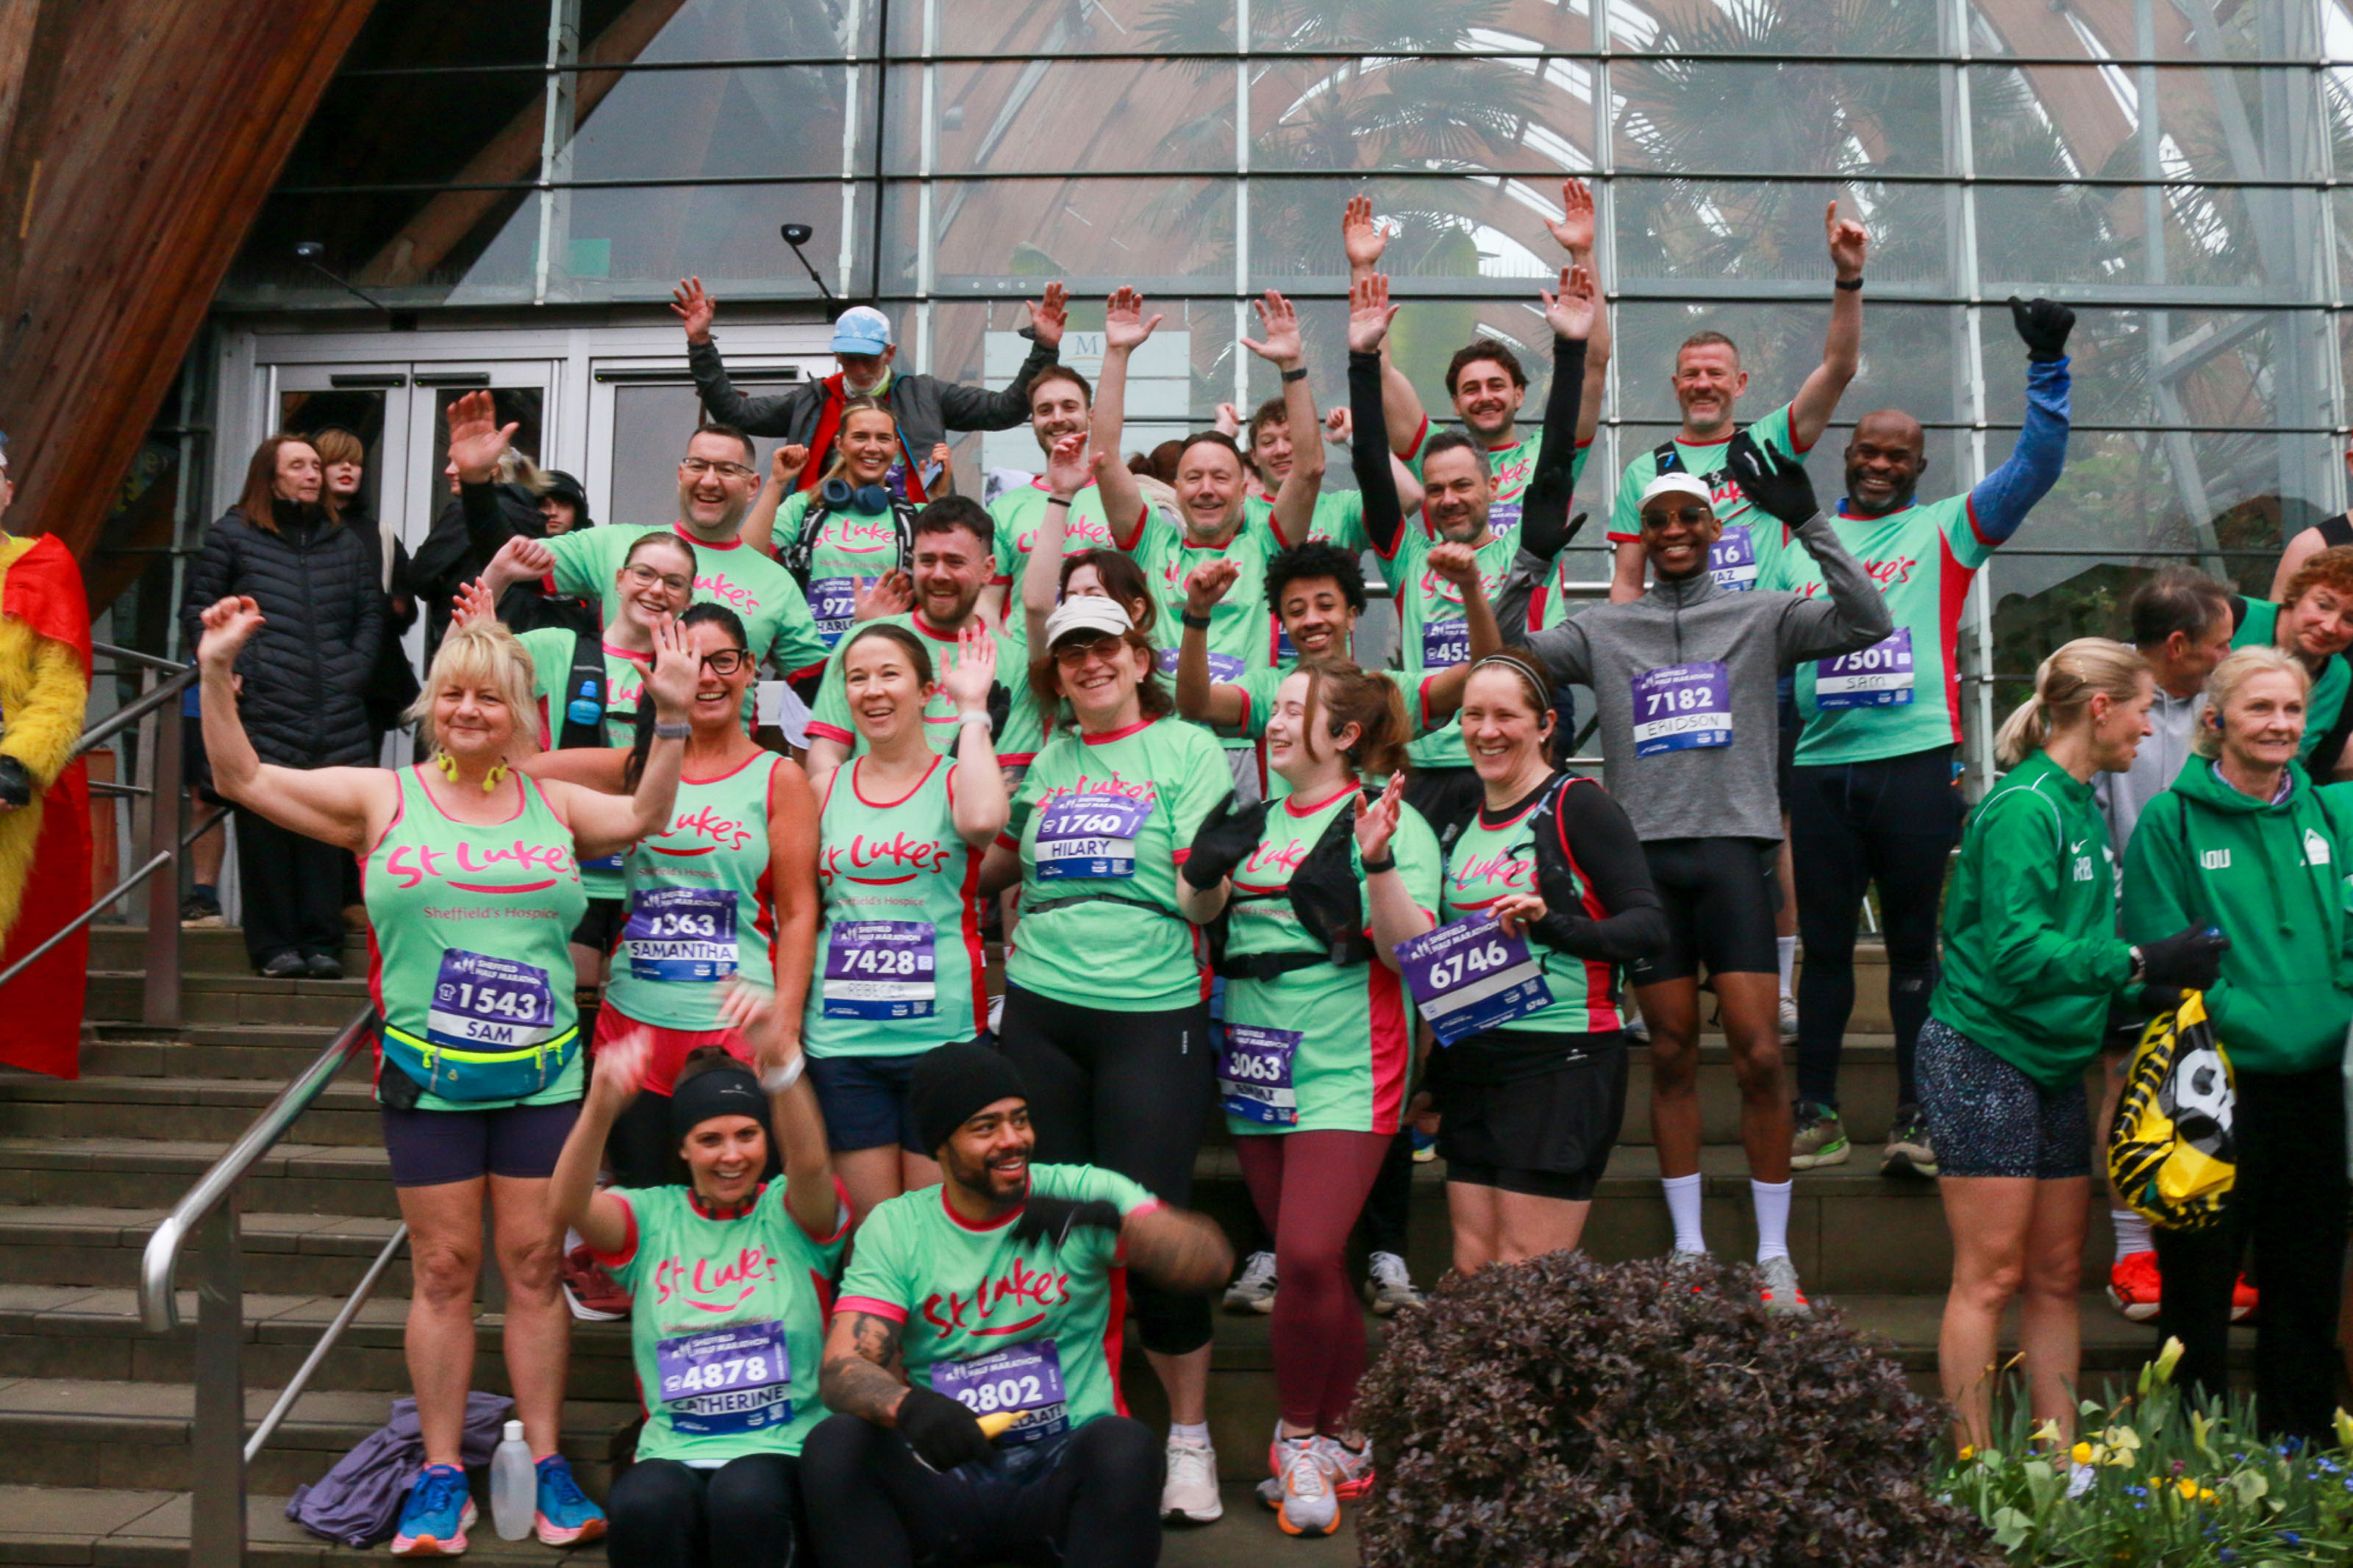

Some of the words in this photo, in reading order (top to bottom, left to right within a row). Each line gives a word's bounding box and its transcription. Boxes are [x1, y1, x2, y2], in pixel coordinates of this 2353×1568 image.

[1076, 334, 1098, 355] M
[1712, 545, 1740, 565] 16
[1832, 649, 1893, 671] 7501
[1646, 687, 1714, 716] 7182
[658, 806, 751, 851] uke's
[1057, 814, 1122, 834] 1760
[850, 831, 951, 874] Luke's
[1051, 840, 1111, 857] HILARY
[387, 845, 448, 889] St
[456, 840, 579, 883] Luke's
[423, 906, 501, 920] Sheffield's
[505, 906, 560, 920] Hospice
[649, 912, 716, 937] 1363
[1429, 924, 1468, 945] SHEFFIELD
[1452, 920, 1499, 945] MARATHON
[630, 942, 733, 959] SAMANTHA
[841, 949, 915, 975] 7428
[1429, 939, 1509, 989] 6746
[459, 983, 538, 1020] 1543
[465, 1021, 513, 1043] SAM
[1229, 1051, 1280, 1081] 3063
[654, 1256, 686, 1305] St
[923, 1292, 971, 1339] St
[976, 1257, 1071, 1319] Luke's
[682, 1356, 768, 1392] 4878
[671, 1385, 785, 1414] CATHERINE
[957, 1375, 1043, 1412] 2802
